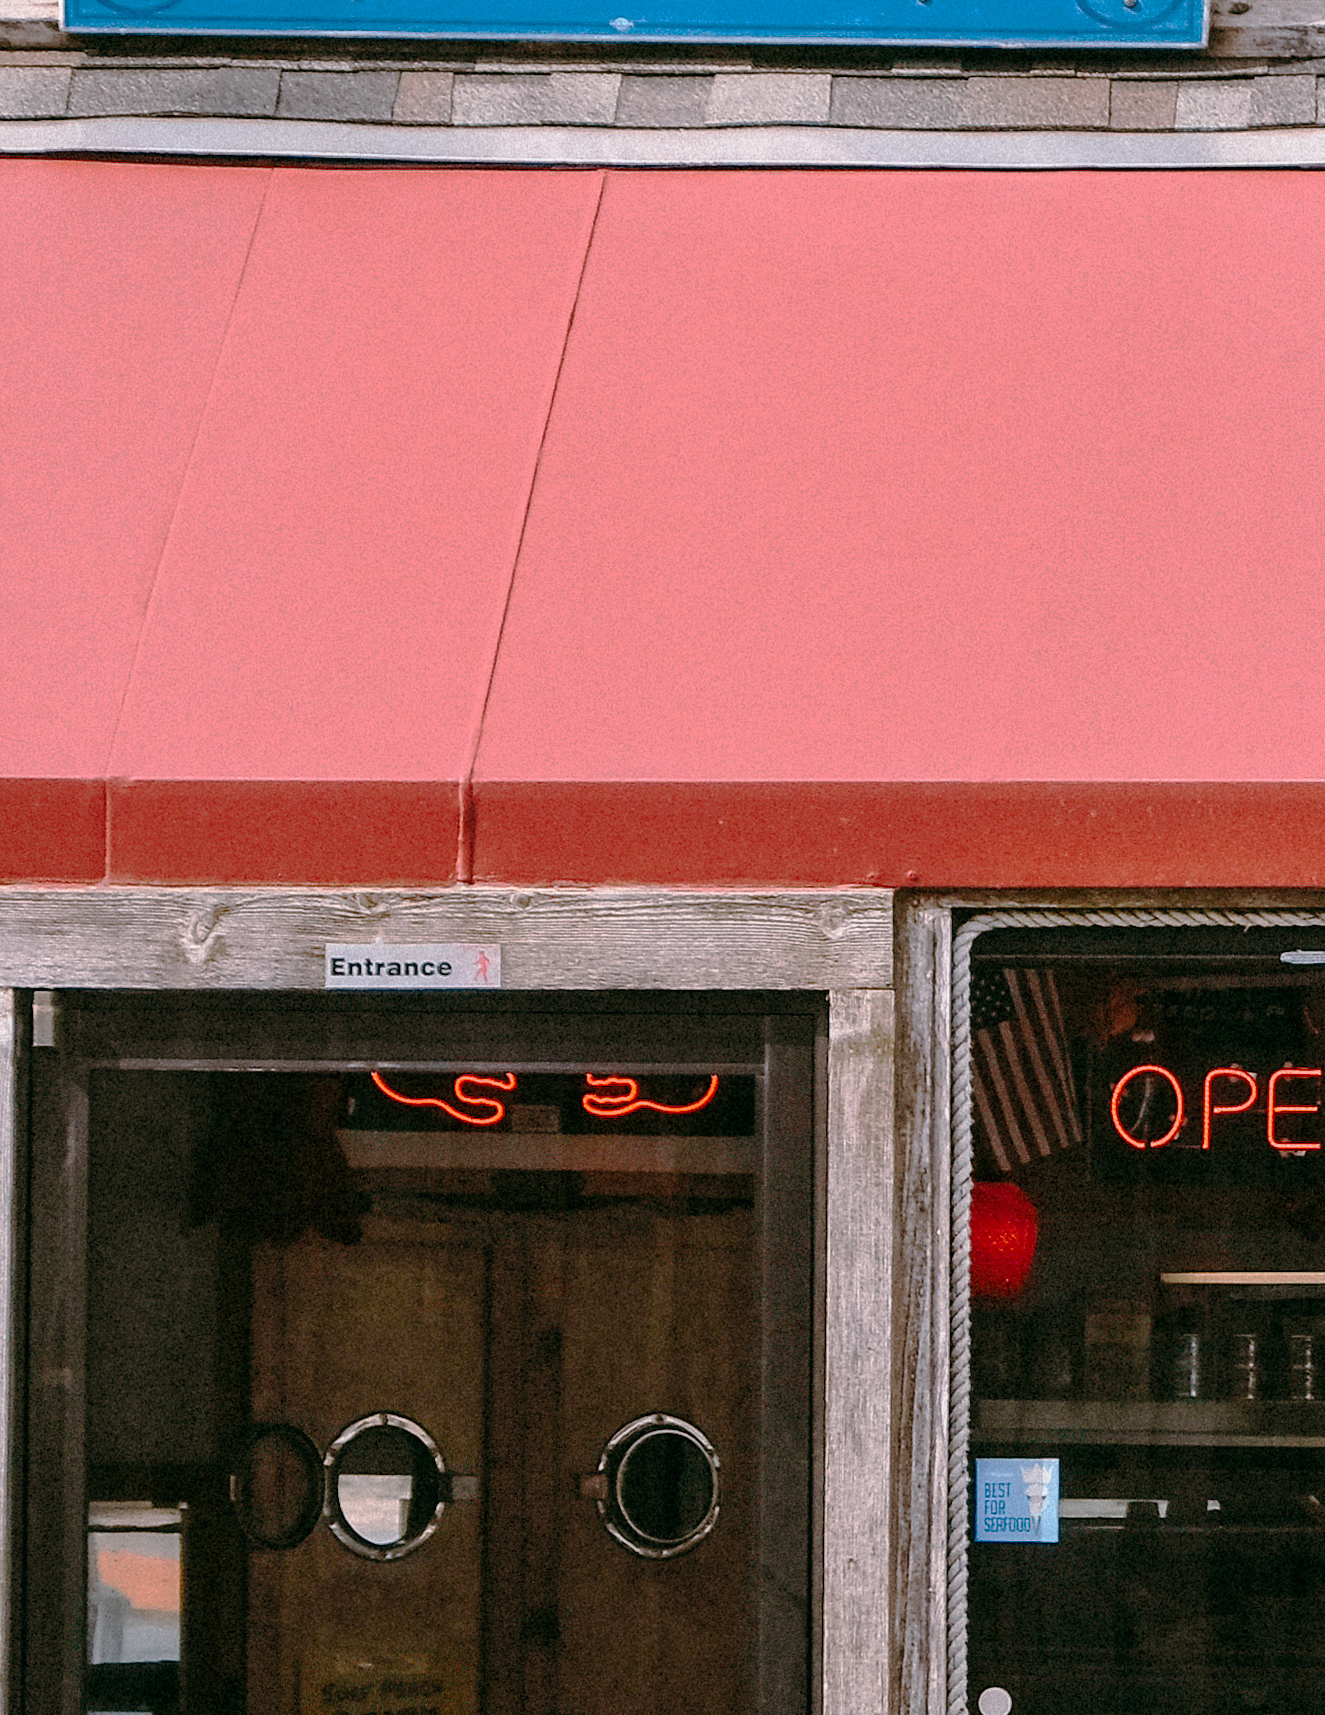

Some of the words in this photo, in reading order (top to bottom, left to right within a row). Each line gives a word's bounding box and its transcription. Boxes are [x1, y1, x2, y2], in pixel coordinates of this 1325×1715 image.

[330, 958, 452, 976] Entrance
[984, 1482, 1011, 1498] BEST
[984, 1499, 1006, 1515] FOR
[984, 1516, 1031, 1533] SEAFOOD
